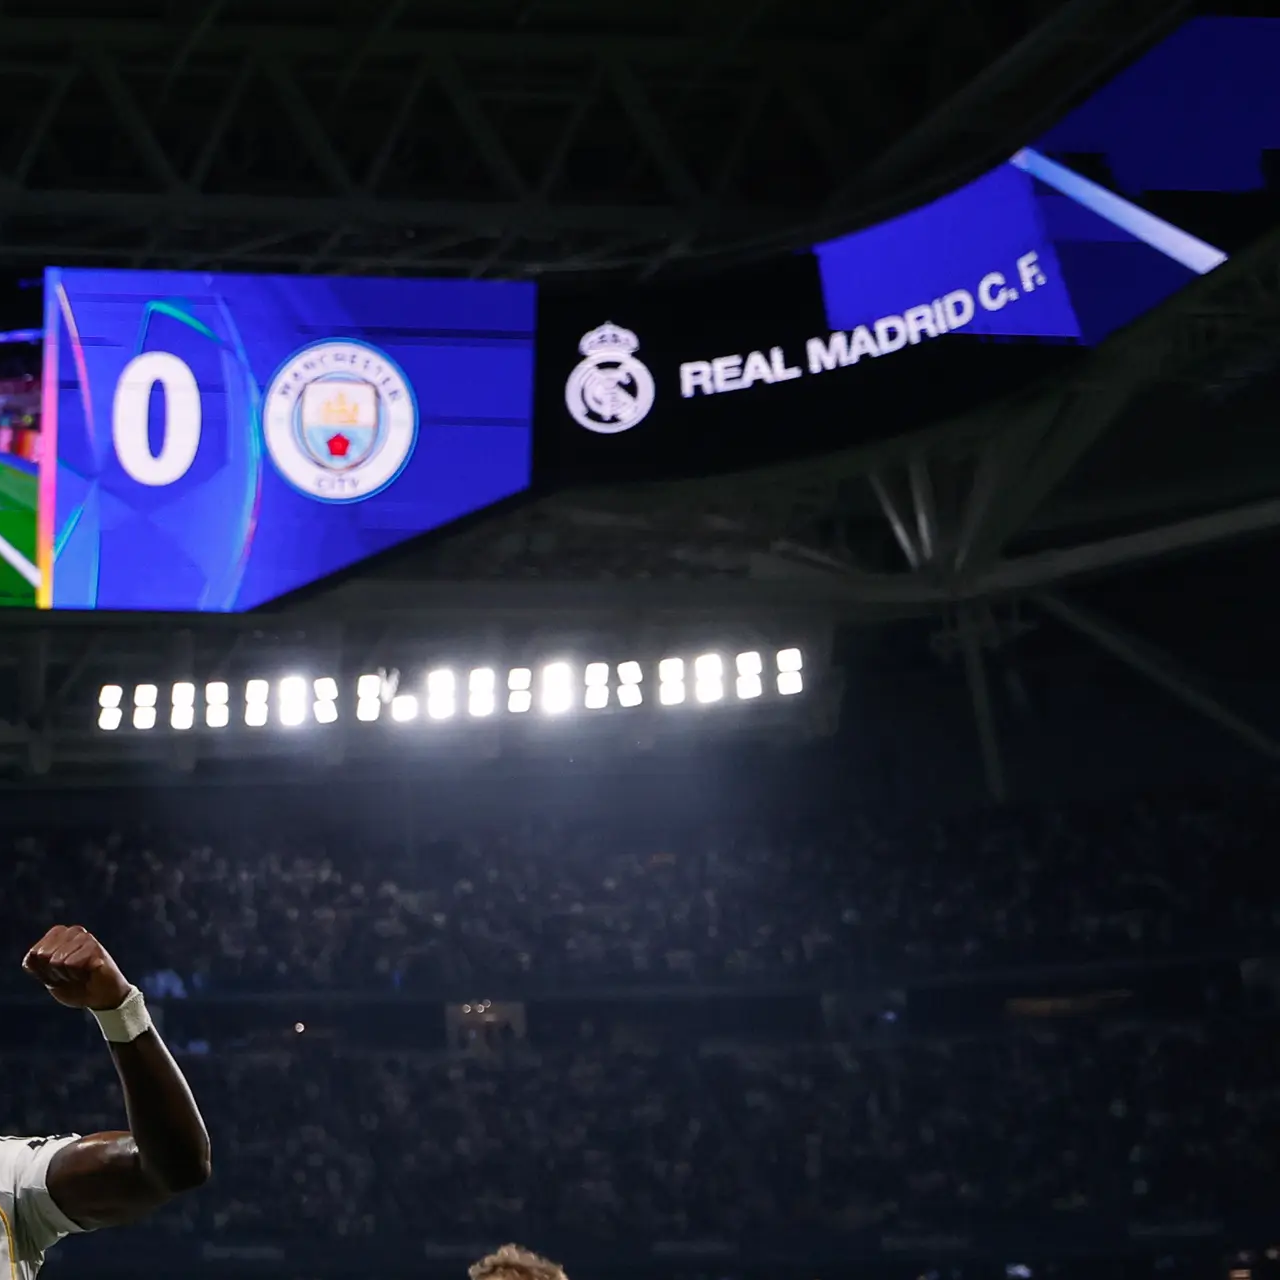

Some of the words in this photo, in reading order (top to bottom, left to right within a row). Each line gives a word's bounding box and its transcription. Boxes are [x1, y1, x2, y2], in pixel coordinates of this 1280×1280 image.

[680, 347, 802, 398] REAL
[807, 289, 976, 373] MADRID
[112, 350, 202, 487] 0
